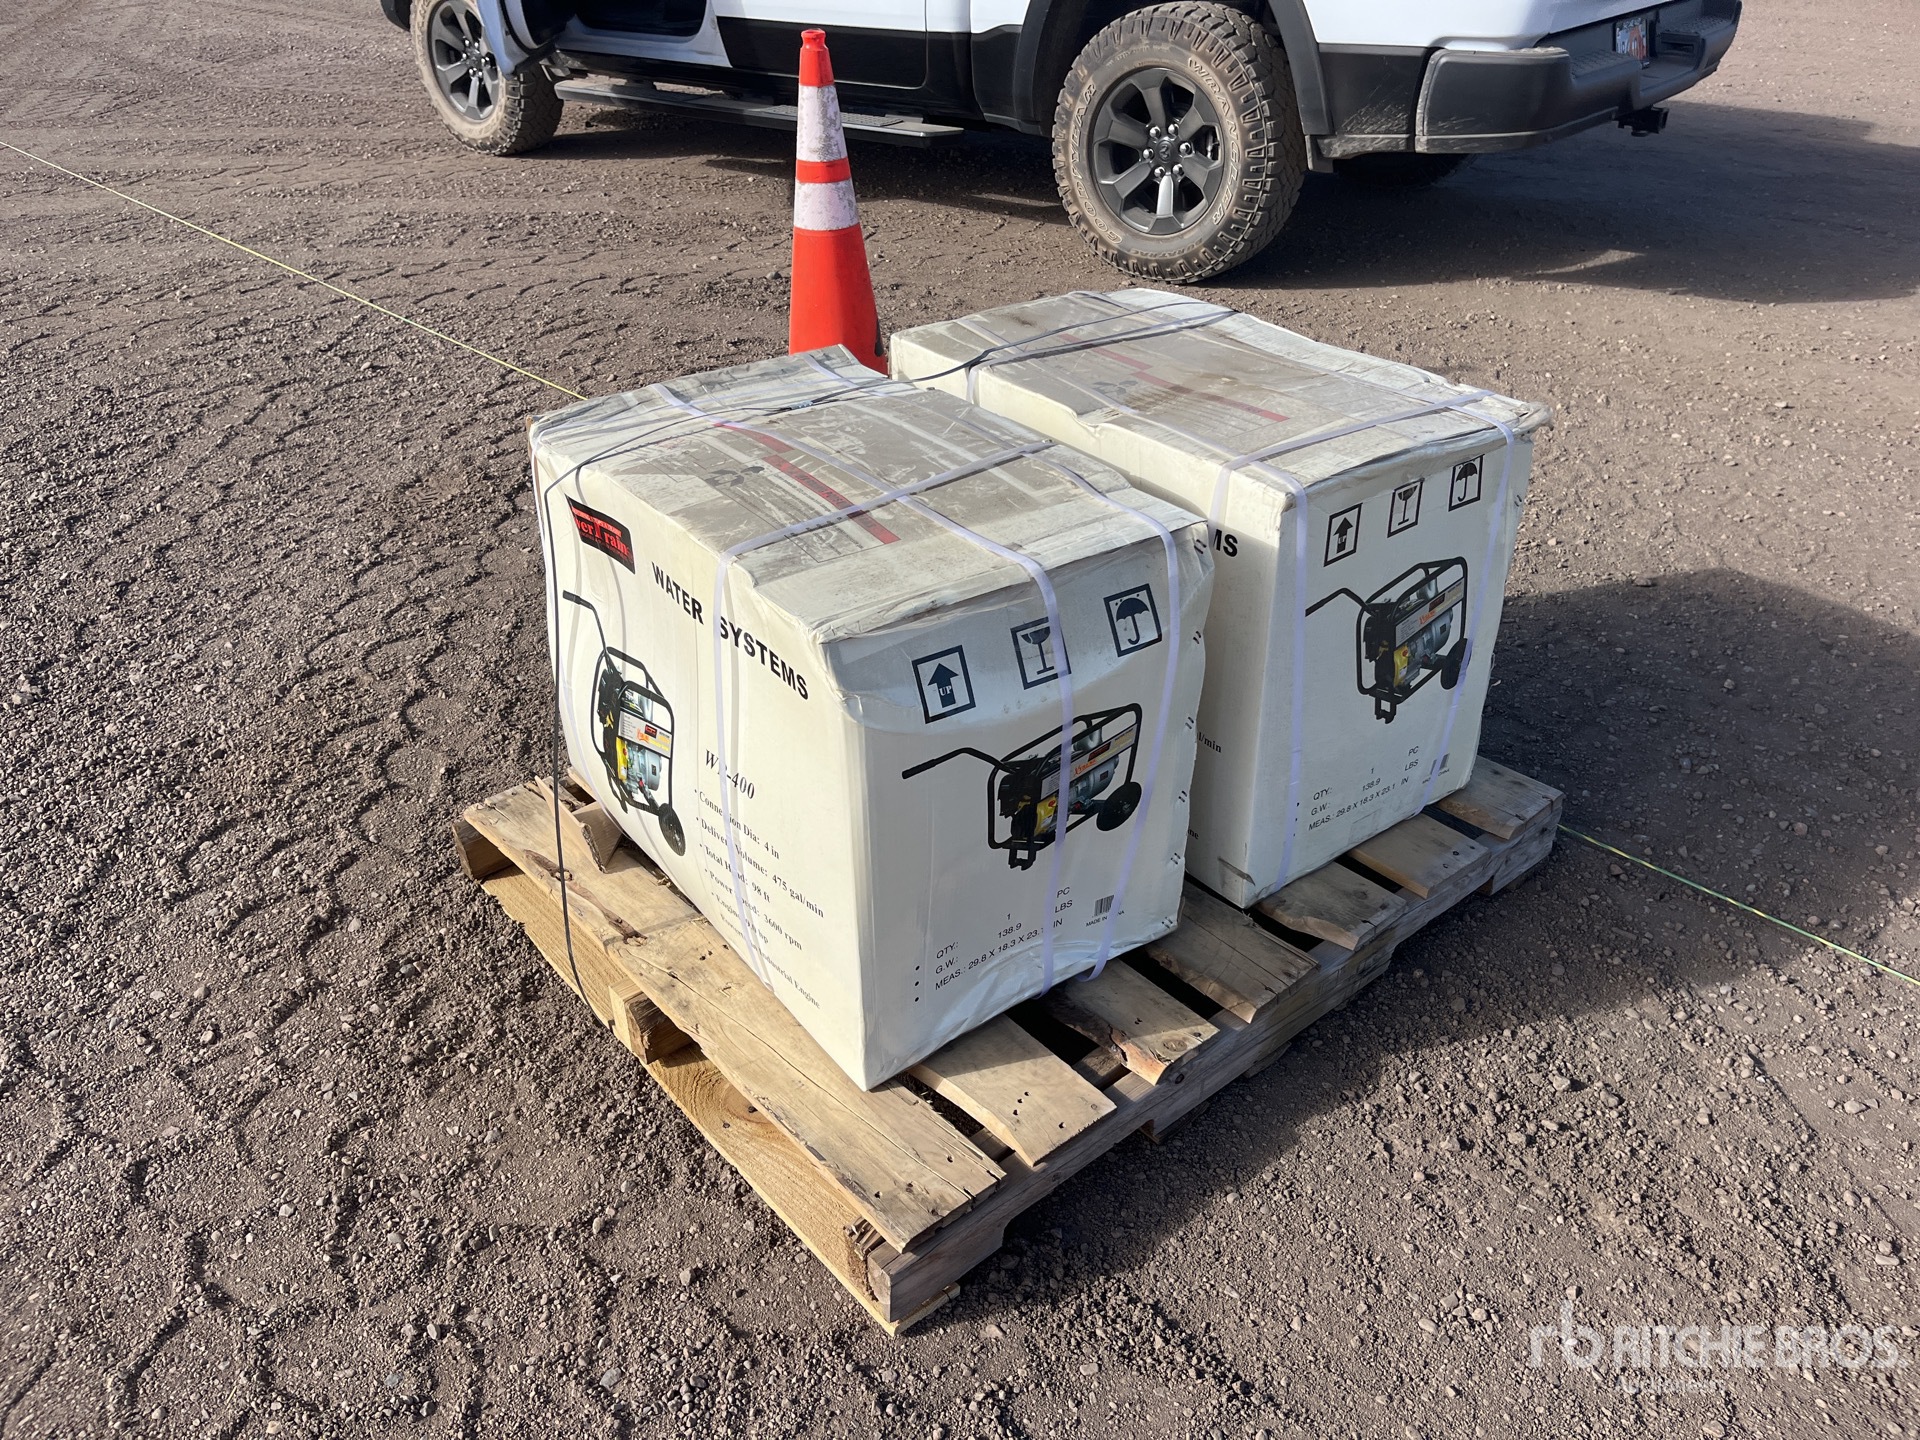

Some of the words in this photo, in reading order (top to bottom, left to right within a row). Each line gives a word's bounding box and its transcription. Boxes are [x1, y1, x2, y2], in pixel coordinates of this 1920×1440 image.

[1070, 83, 1123, 244] GOODYEAR
[1188, 57, 1241, 226] WRANGLER
[651, 561, 705, 626] WATER
[719, 615, 809, 701] SYSTEMS
[938, 685, 952, 697] UP
[705, 748, 755, 800] W-400
[1362, 777, 1381, 792] 138.9
[1404, 758, 1419, 772] LBS
[1408, 745, 1419, 757] PC
[1400, 776, 1410, 786] IN
[704, 843, 724, 866] Total
[743, 824, 760, 845] Dia:
[771, 845, 780, 860] in
[734, 843, 768, 877] Volume:
[772, 874, 788, 892] 475
[789, 887, 824, 919] gal/min
[784, 929, 803, 951] rpm
[935, 956, 959, 975] G.W.:
[997, 922, 1023, 939] 138.9
[1054, 899, 1073, 914] LBS
[936, 941, 959, 960] QTY.:
[1056, 886, 1071, 899] PC
[1085, 917, 1101, 928] MADE
[935, 966, 966, 991] MEAS.:
[968, 955, 987, 971] 29.8
[988, 948, 996, 958] X
[997, 939, 1016, 954] 18.3
[1018, 934, 1025, 944] X
[1053, 918, 1064, 929] IN
